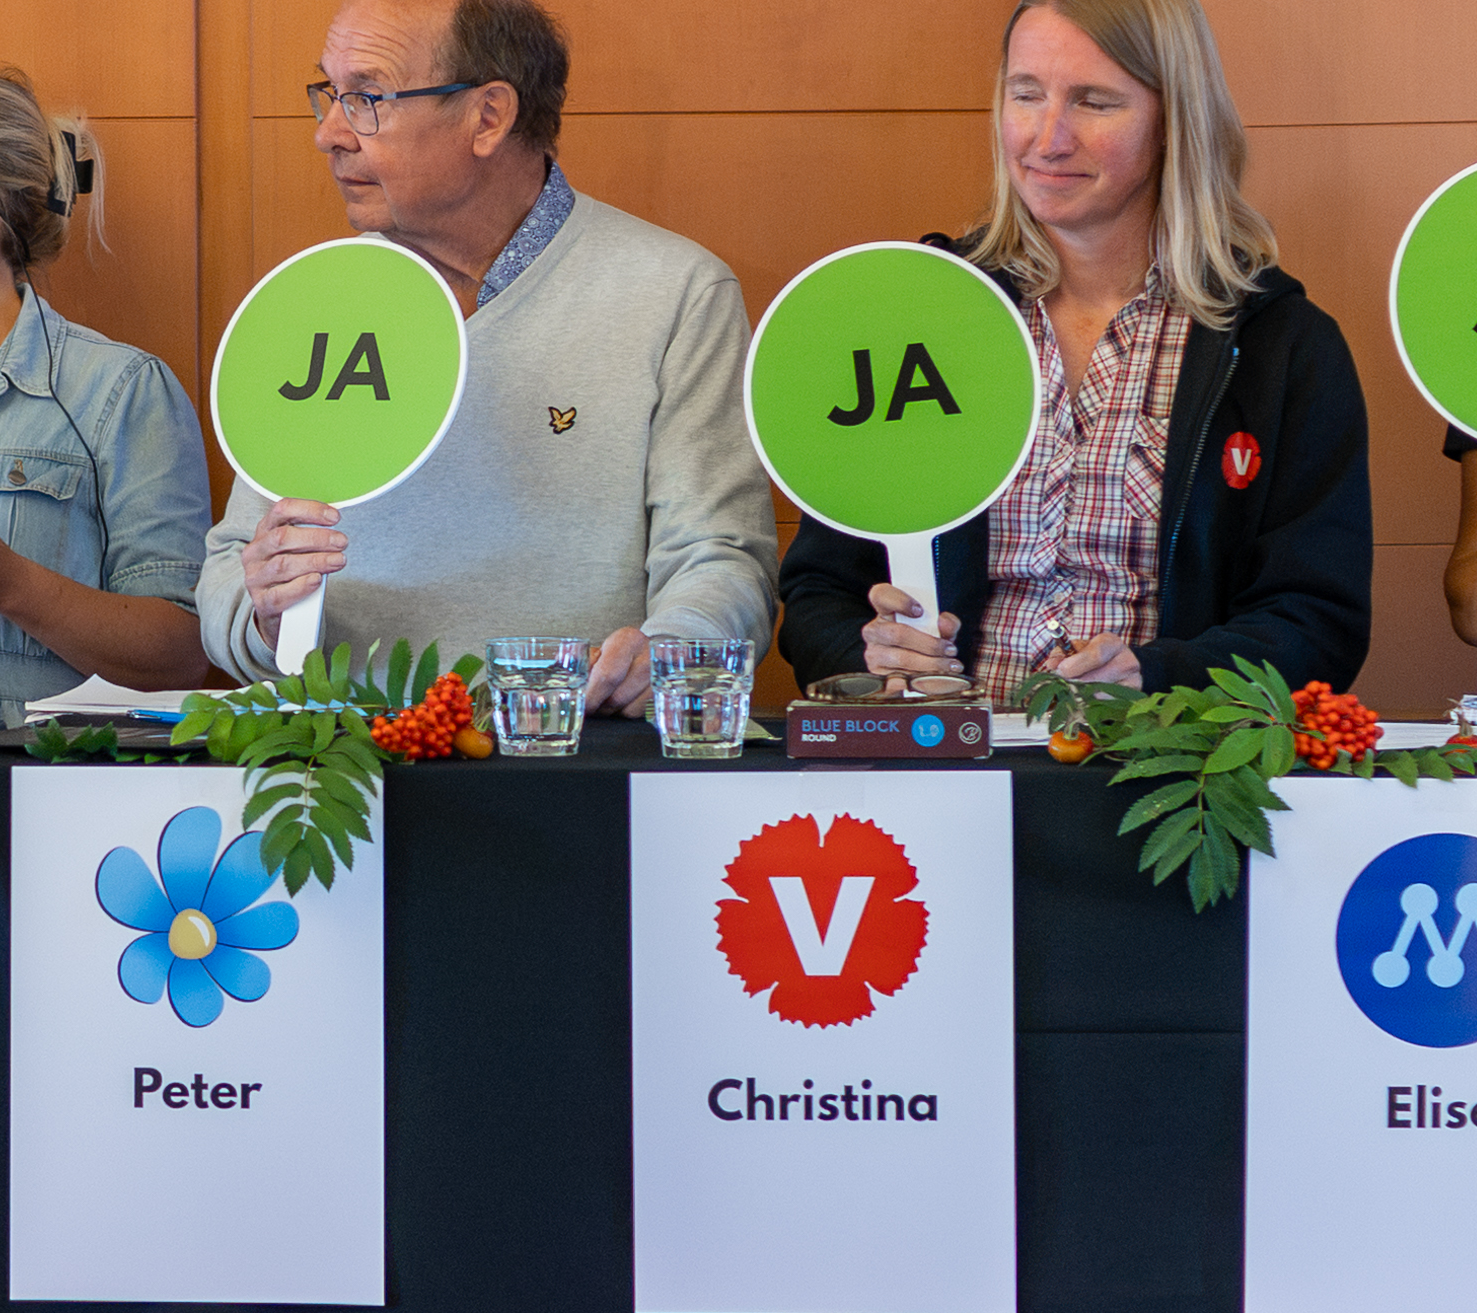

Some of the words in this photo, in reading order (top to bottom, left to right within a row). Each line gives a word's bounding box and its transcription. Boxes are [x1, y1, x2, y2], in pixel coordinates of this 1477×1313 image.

[277, 332, 391, 402] JA
[826, 342, 962, 427] JA
[1230, 447, 1252, 476] V
[801, 720, 841, 732] BLUE
[845, 720, 900, 733] BLOCK
[801, 734, 837, 742] ROUND
[767, 876, 876, 977] V
[133, 1067, 263, 1110] Peter
[707, 1077, 939, 1122] Christina
